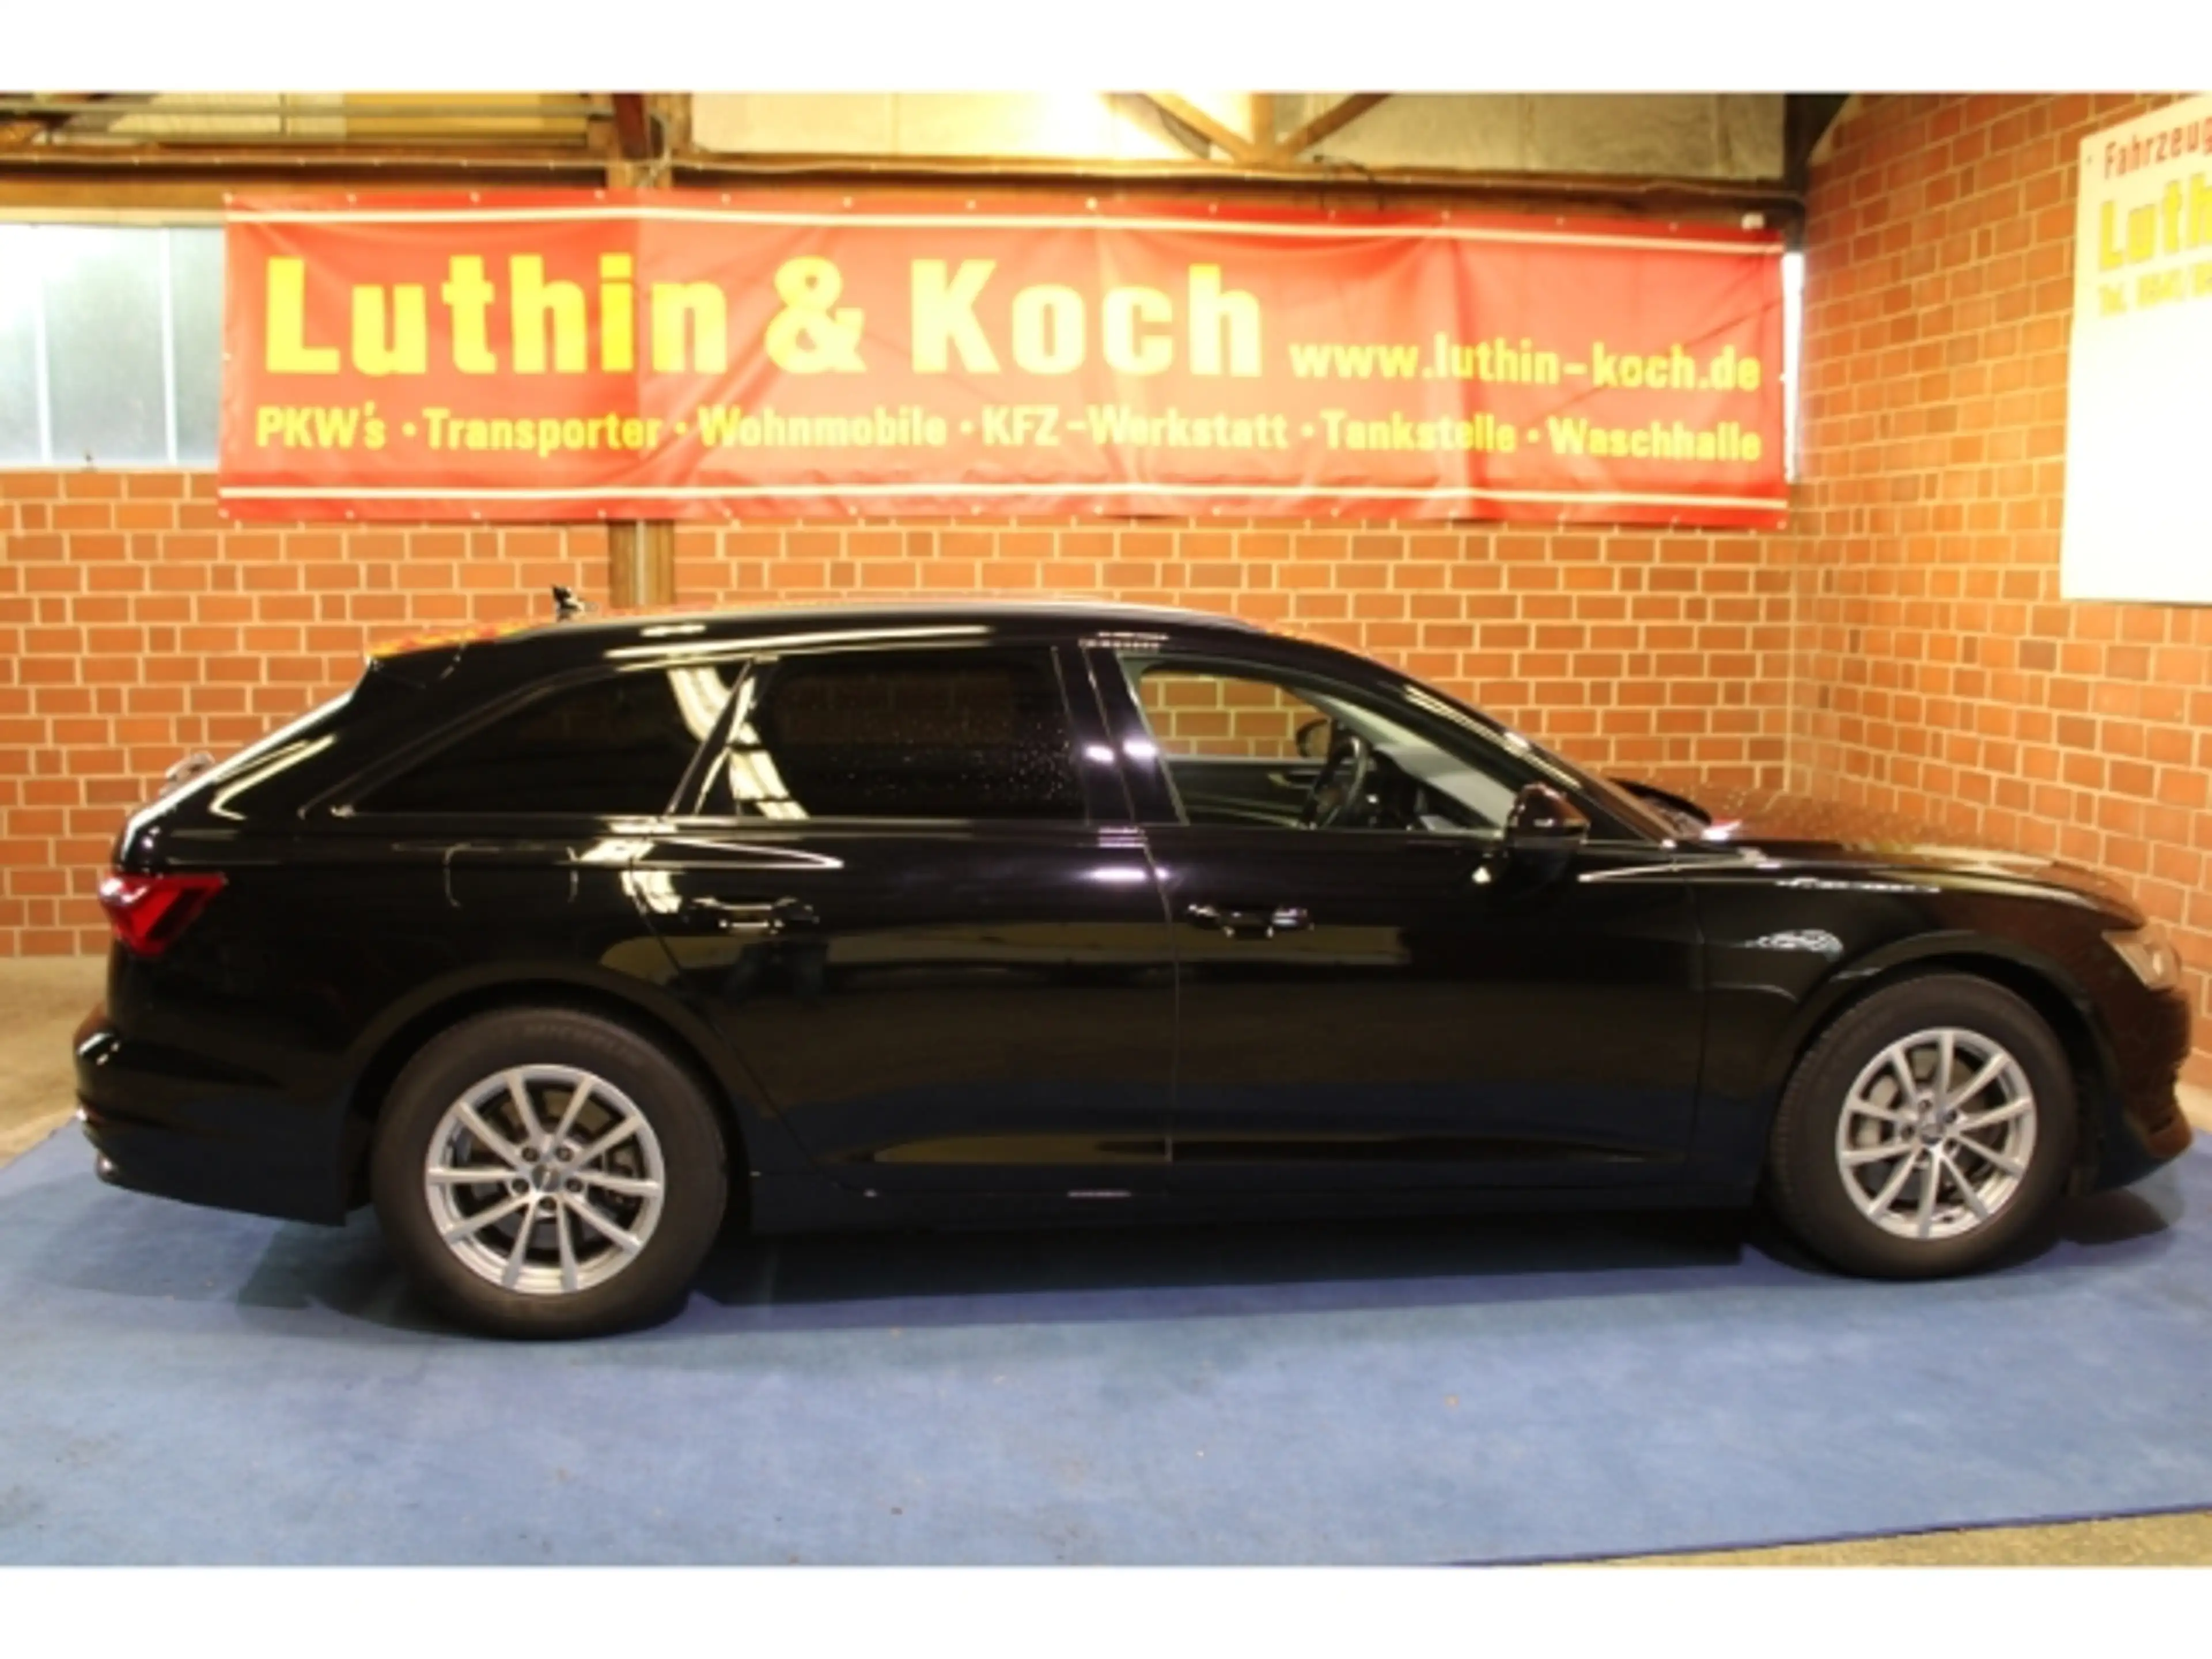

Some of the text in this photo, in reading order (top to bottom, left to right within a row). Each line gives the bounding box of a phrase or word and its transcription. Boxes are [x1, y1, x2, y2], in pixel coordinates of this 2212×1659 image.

[266, 252, 1760, 393] Luthin & Koch www.luthin-koch.de
[422, 408, 662, 457] Transporter
[698, 407, 946, 448] Wohnmobile
[1321, 410, 1518, 452] Tankstelle
[1547, 416, 1760, 461] Waschhalle
